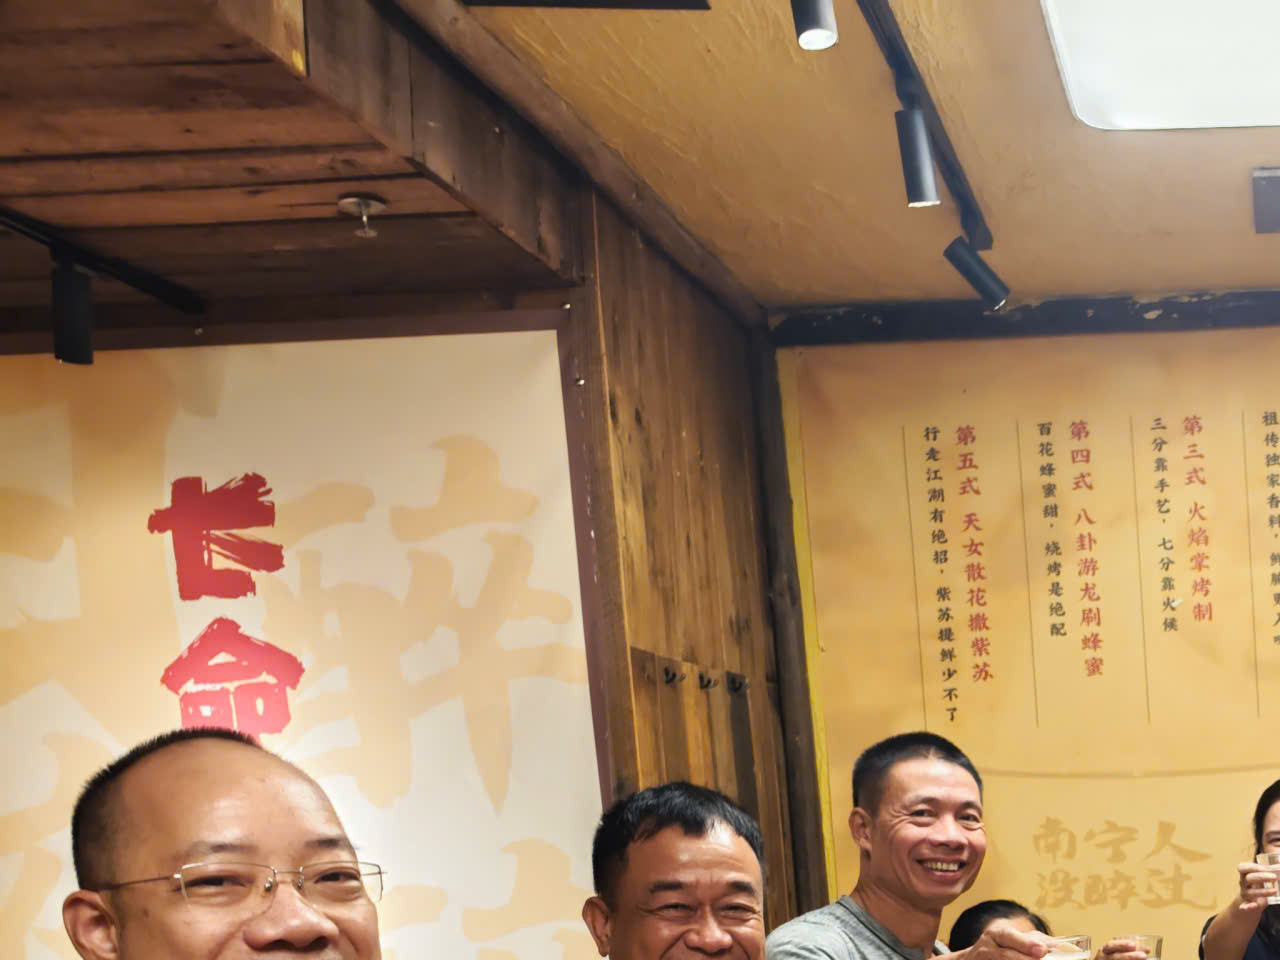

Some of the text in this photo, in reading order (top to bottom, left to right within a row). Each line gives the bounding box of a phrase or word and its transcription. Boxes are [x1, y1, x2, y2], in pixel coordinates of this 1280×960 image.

[955, 424, 981, 496] 第五式
[1069, 419, 1093, 491] 第四式
[1182, 414, 1207, 487] 第三式
